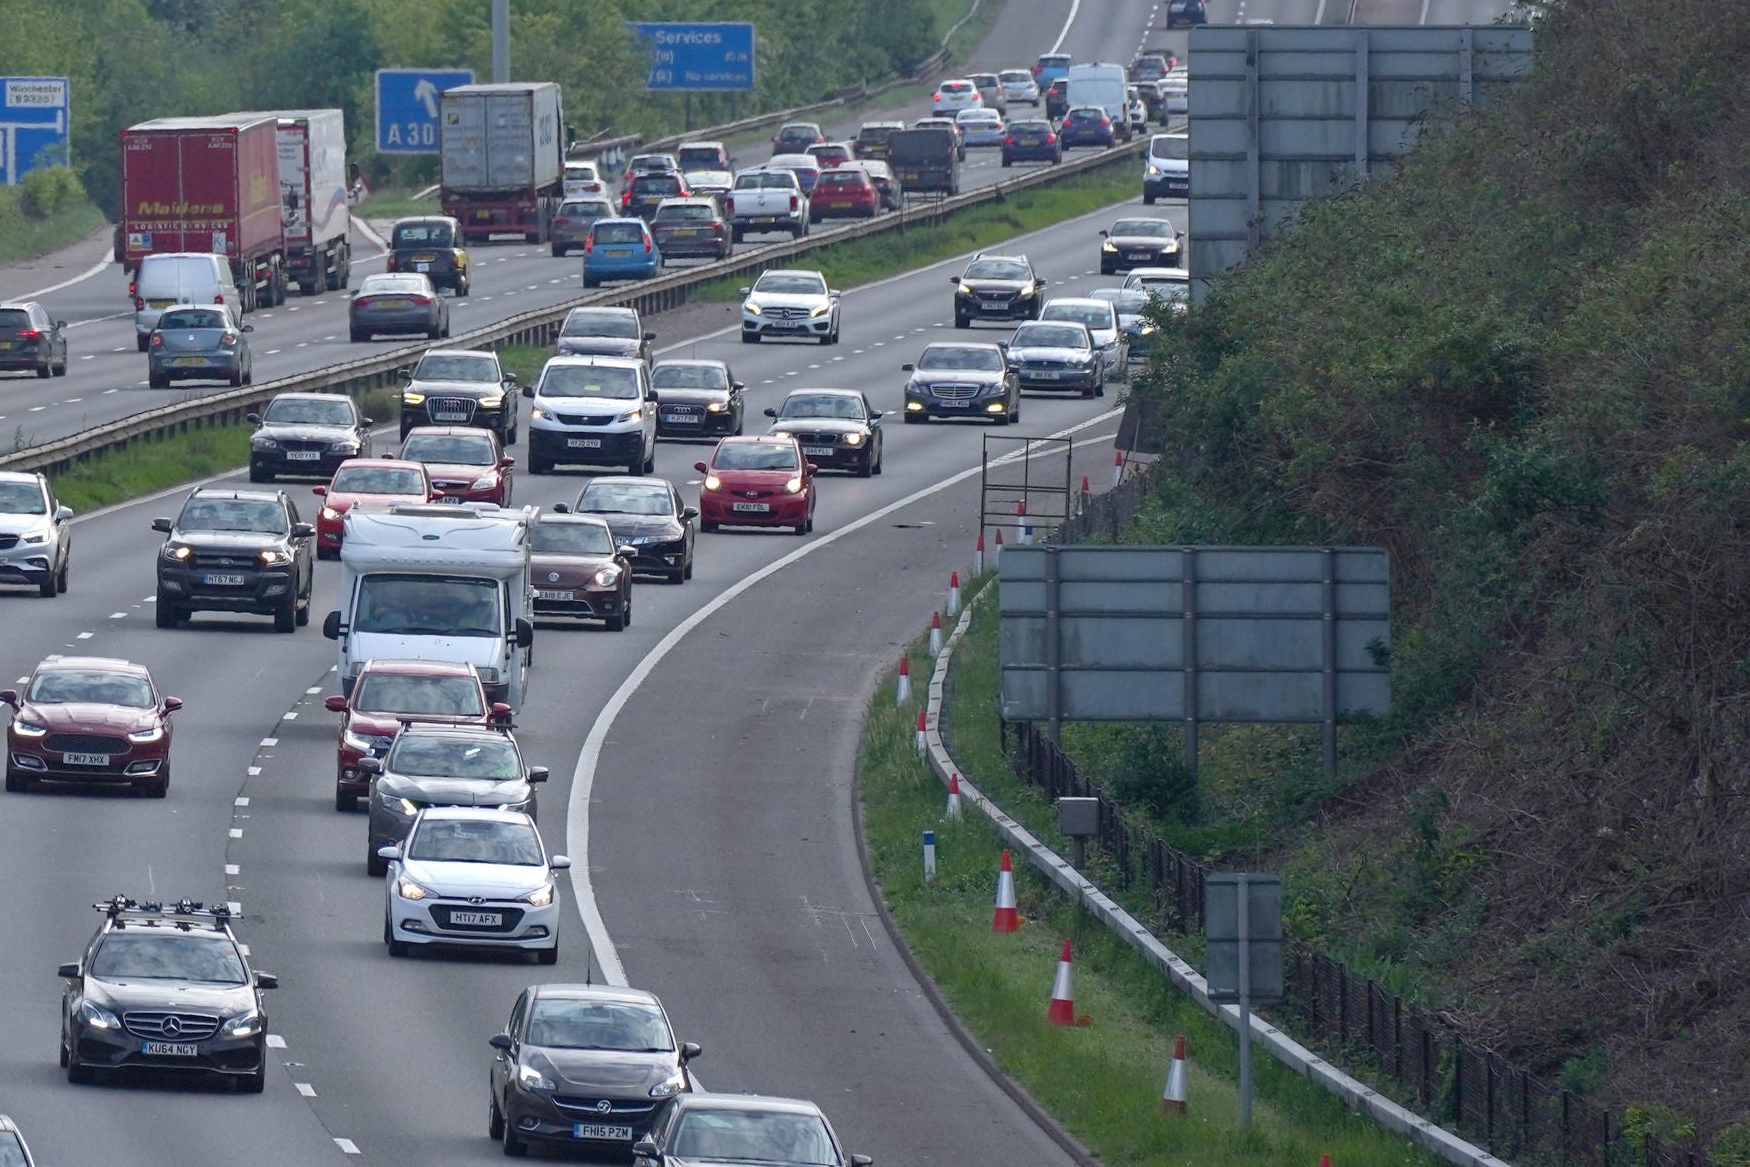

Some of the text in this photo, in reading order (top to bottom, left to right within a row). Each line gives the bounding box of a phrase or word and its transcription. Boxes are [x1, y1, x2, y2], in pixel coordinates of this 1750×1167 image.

[655, 30, 722, 44] Services
[9, 85, 61, 93] Winchester
[138, 202, 225, 215] Maidens
[68, 754, 104, 764] FM17 XHX
[455, 914, 497, 924] HT17 AFX
[148, 1042, 195, 1055] KU64 NGY
[583, 1126, 607, 1137] FH15
